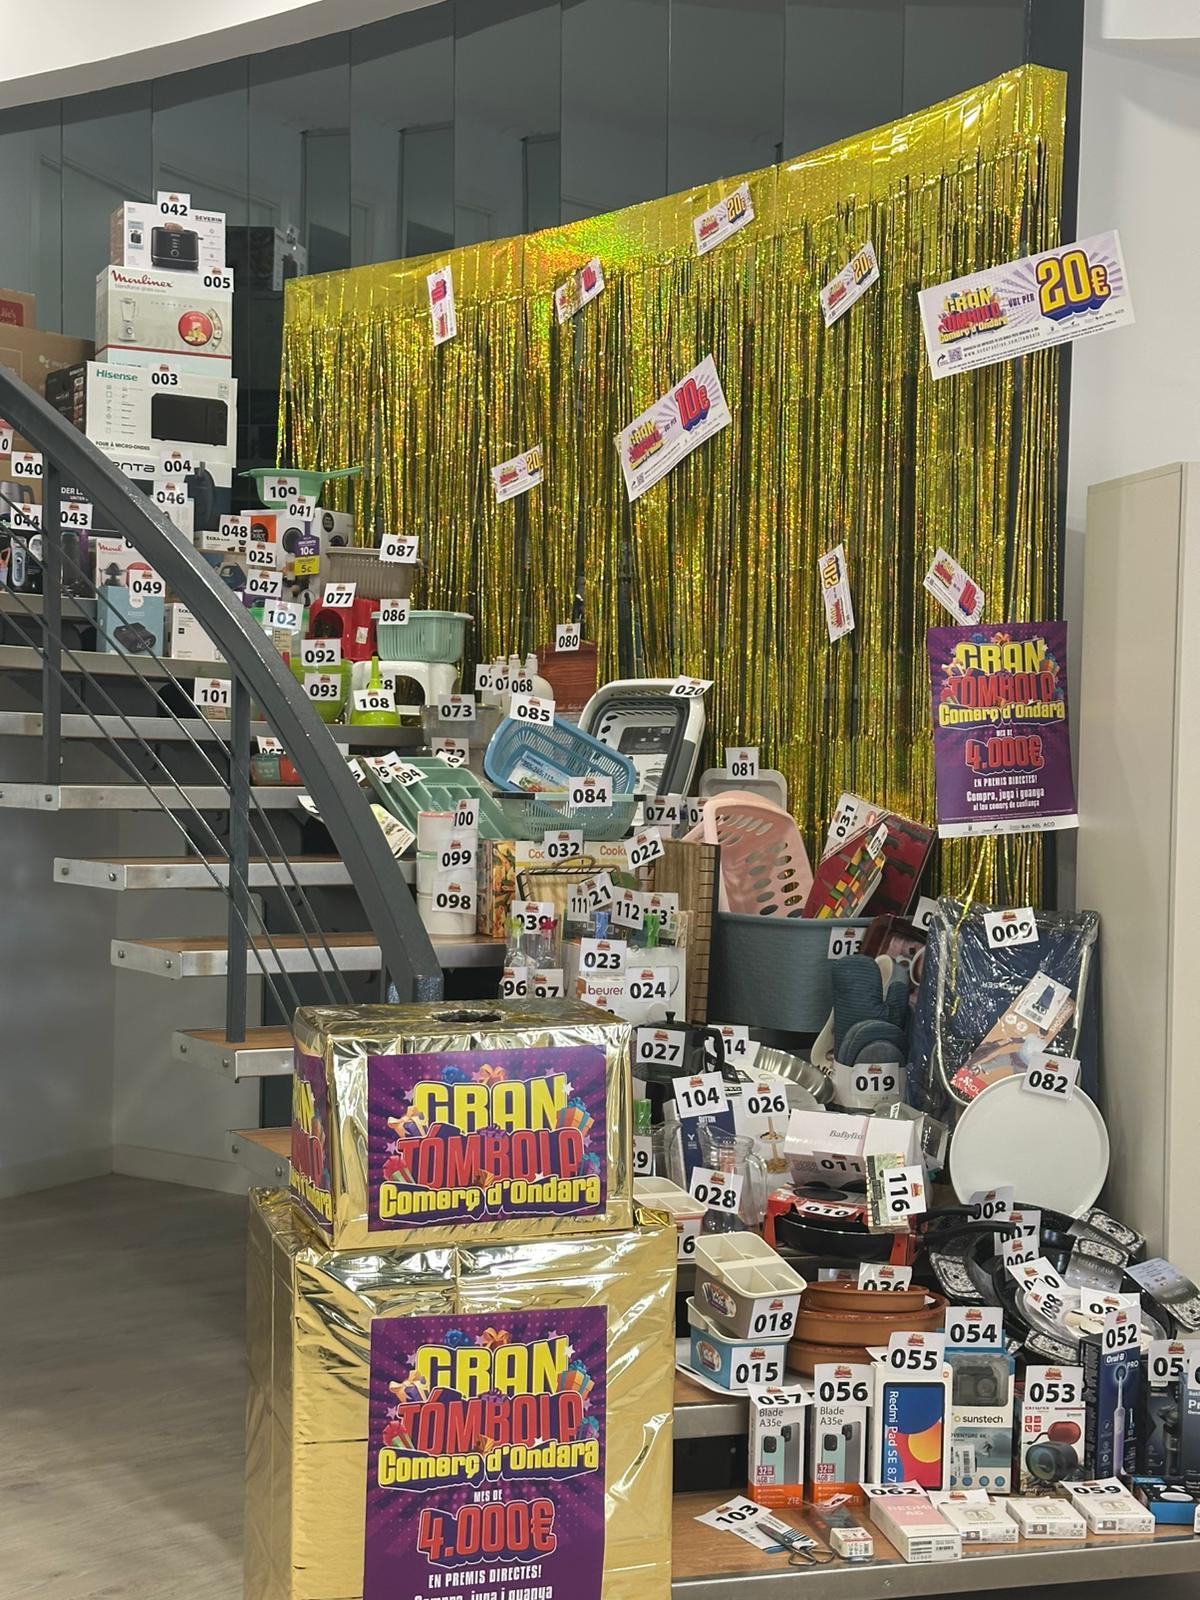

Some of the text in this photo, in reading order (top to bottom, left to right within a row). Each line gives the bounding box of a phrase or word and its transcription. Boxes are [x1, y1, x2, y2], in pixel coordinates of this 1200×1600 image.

[160, 202, 188, 216] 042
[194, 214, 222, 223] SEVERIN
[110, 270, 174, 288] Moulinex
[203, 276, 230, 289] 005
[1036, 250, 1111, 317] 20€
[944, 286, 992, 311] GRAN
[96, 369, 138, 382] Hisense
[152, 372, 178, 386] 003
[14, 462, 43, 476] 040
[164, 460, 192, 472] 004
[156, 491, 185, 505] 046
[270, 486, 298, 498] 109
[60, 511, 89, 526] 043
[289, 504, 311, 518] 041
[14, 513, 40, 528] 044
[221, 524, 248, 538] 048
[249, 550, 274, 564] 025
[386, 544, 415, 558] 087
[132, 580, 162, 594] 049
[250, 578, 279, 594] 047
[326, 592, 353, 604] 077
[268, 610, 296, 626] 102
[382, 609, 406, 622] 086
[558, 634, 578, 648] 080
[304, 650, 336, 663] 092
[954, 638, 1045, 674] GRAN
[309, 684, 338, 698] 093
[495, 676, 510, 691] 07
[511, 679, 533, 693] 068
[675, 684, 705, 696] 020
[201, 689, 228, 704] 101
[360, 698, 390, 709] 108
[440, 705, 472, 718] 073
[517, 704, 550, 722] 085
[966, 736, 1044, 770] 4.000€
[395, 768, 422, 785] 094
[732, 762, 755, 777] 081
[572, 788, 607, 804] 084
[646, 806, 676, 820] 074
[690, 808, 704, 822] 07
[836, 804, 855, 838] 031
[548, 842, 580, 858] 032
[630, 840, 661, 864] 022
[442, 850, 472, 868] 099
[436, 893, 472, 910] 098
[588, 885, 612, 906] 21
[616, 900, 640, 920] 112
[992, 924, 1033, 943] 009
[832, 940, 862, 955] 013
[584, 952, 621, 969] 023
[504, 980, 527, 996] 96
[534, 986, 560, 998] 97
[588, 983, 624, 996] beurer
[630, 982, 666, 999] 024
[640, 1042, 680, 1062] 027
[724, 1038, 746, 1055] 14
[855, 1076, 895, 1092] 019
[1028, 1070, 1068, 1094] 082
[413, 1072, 567, 1134] GRAN
[682, 1086, 720, 1108] 104
[748, 1095, 786, 1114] 026
[829, 1130, 865, 1140] BaByliss
[398, 1125, 584, 1188] TÓMBOLA
[820, 1159, 862, 1173] 011
[380, 1176, 600, 1213] Comerç d'Ondara
[694, 1184, 737, 1208] 028
[888, 1172, 911, 1212] 116
[804, 1205, 850, 1216] 010
[754, 1312, 794, 1334] 018
[950, 1324, 998, 1343] 054
[1106, 1324, 1138, 1348] 052
[416, 1336, 570, 1399] GRAN
[891, 1348, 938, 1371] 055
[1126, 1360, 1138, 1369] PRO
[1154, 1357, 1191, 1376] 05
[736, 1362, 778, 1384] 015
[758, 1393, 802, 1406] 057
[819, 1382, 868, 1402] 056
[1030, 1383, 1076, 1403] 053
[760, 1408, 784, 1418] Blade
[820, 1406, 845, 1416] Blade
[888, 1390, 899, 1423] Redmi
[399, 1388, 584, 1455] TÓMBOLA
[759, 1418, 782, 1428] A35e
[820, 1416, 843, 1426] A35e
[962, 1414, 1004, 1426] sunstech
[888, 1426, 898, 1446] Pad
[378, 1438, 599, 1481] Comerç d'Ondara
[888, 1449, 898, 1464] SE
[474, 1490, 503, 1502] MES DE
[870, 1488, 921, 1496] 062
[1073, 1486, 1122, 1495] 059
[716, 1504, 758, 1524] 103
[419, 1499, 556, 1561] 4.000€
[428, 1564, 542, 1588] EN PREMIS DIRECTES!
